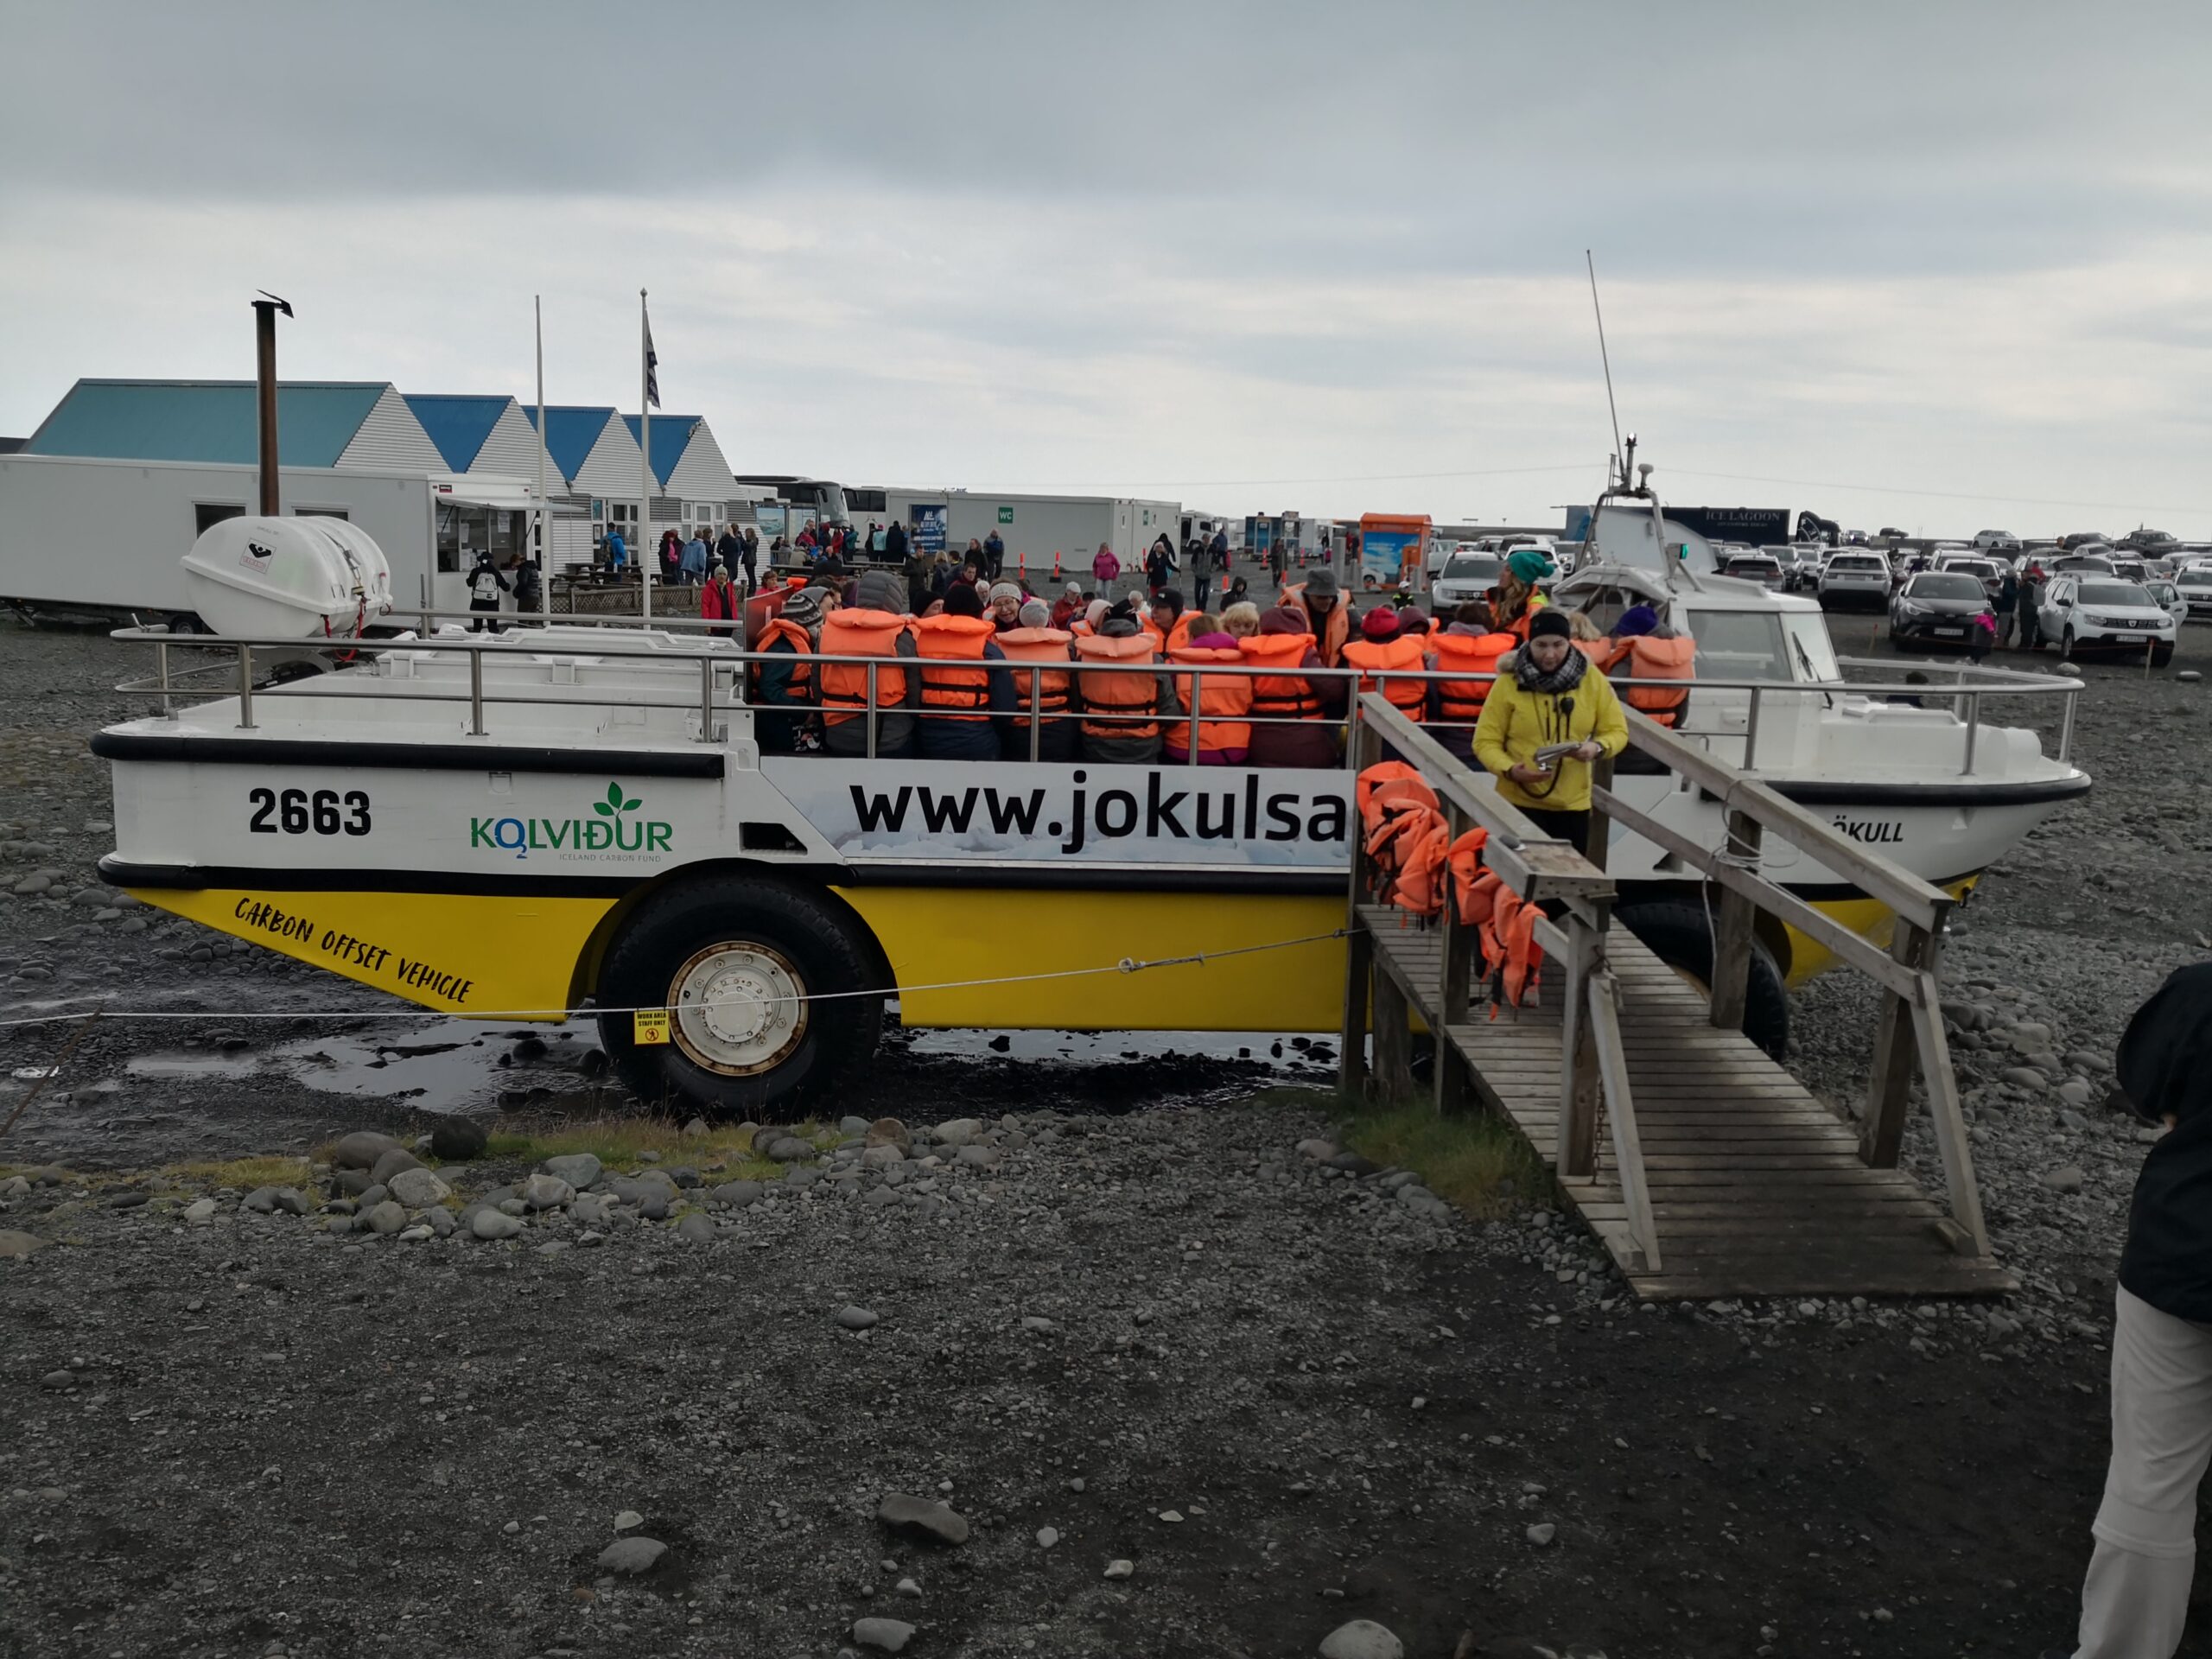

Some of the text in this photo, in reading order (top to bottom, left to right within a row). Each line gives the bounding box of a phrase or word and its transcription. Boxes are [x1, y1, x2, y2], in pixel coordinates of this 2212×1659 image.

[999, 512, 1012, 520] WC
[1729, 512, 1780, 521] LAGOON
[250, 788, 372, 836] 2663
[1827, 815, 1904, 842] ÖKULL
[600, 854, 635, 862] CARBON
[234, 897, 475, 1004] CARBON OFFSET VEHICLE
